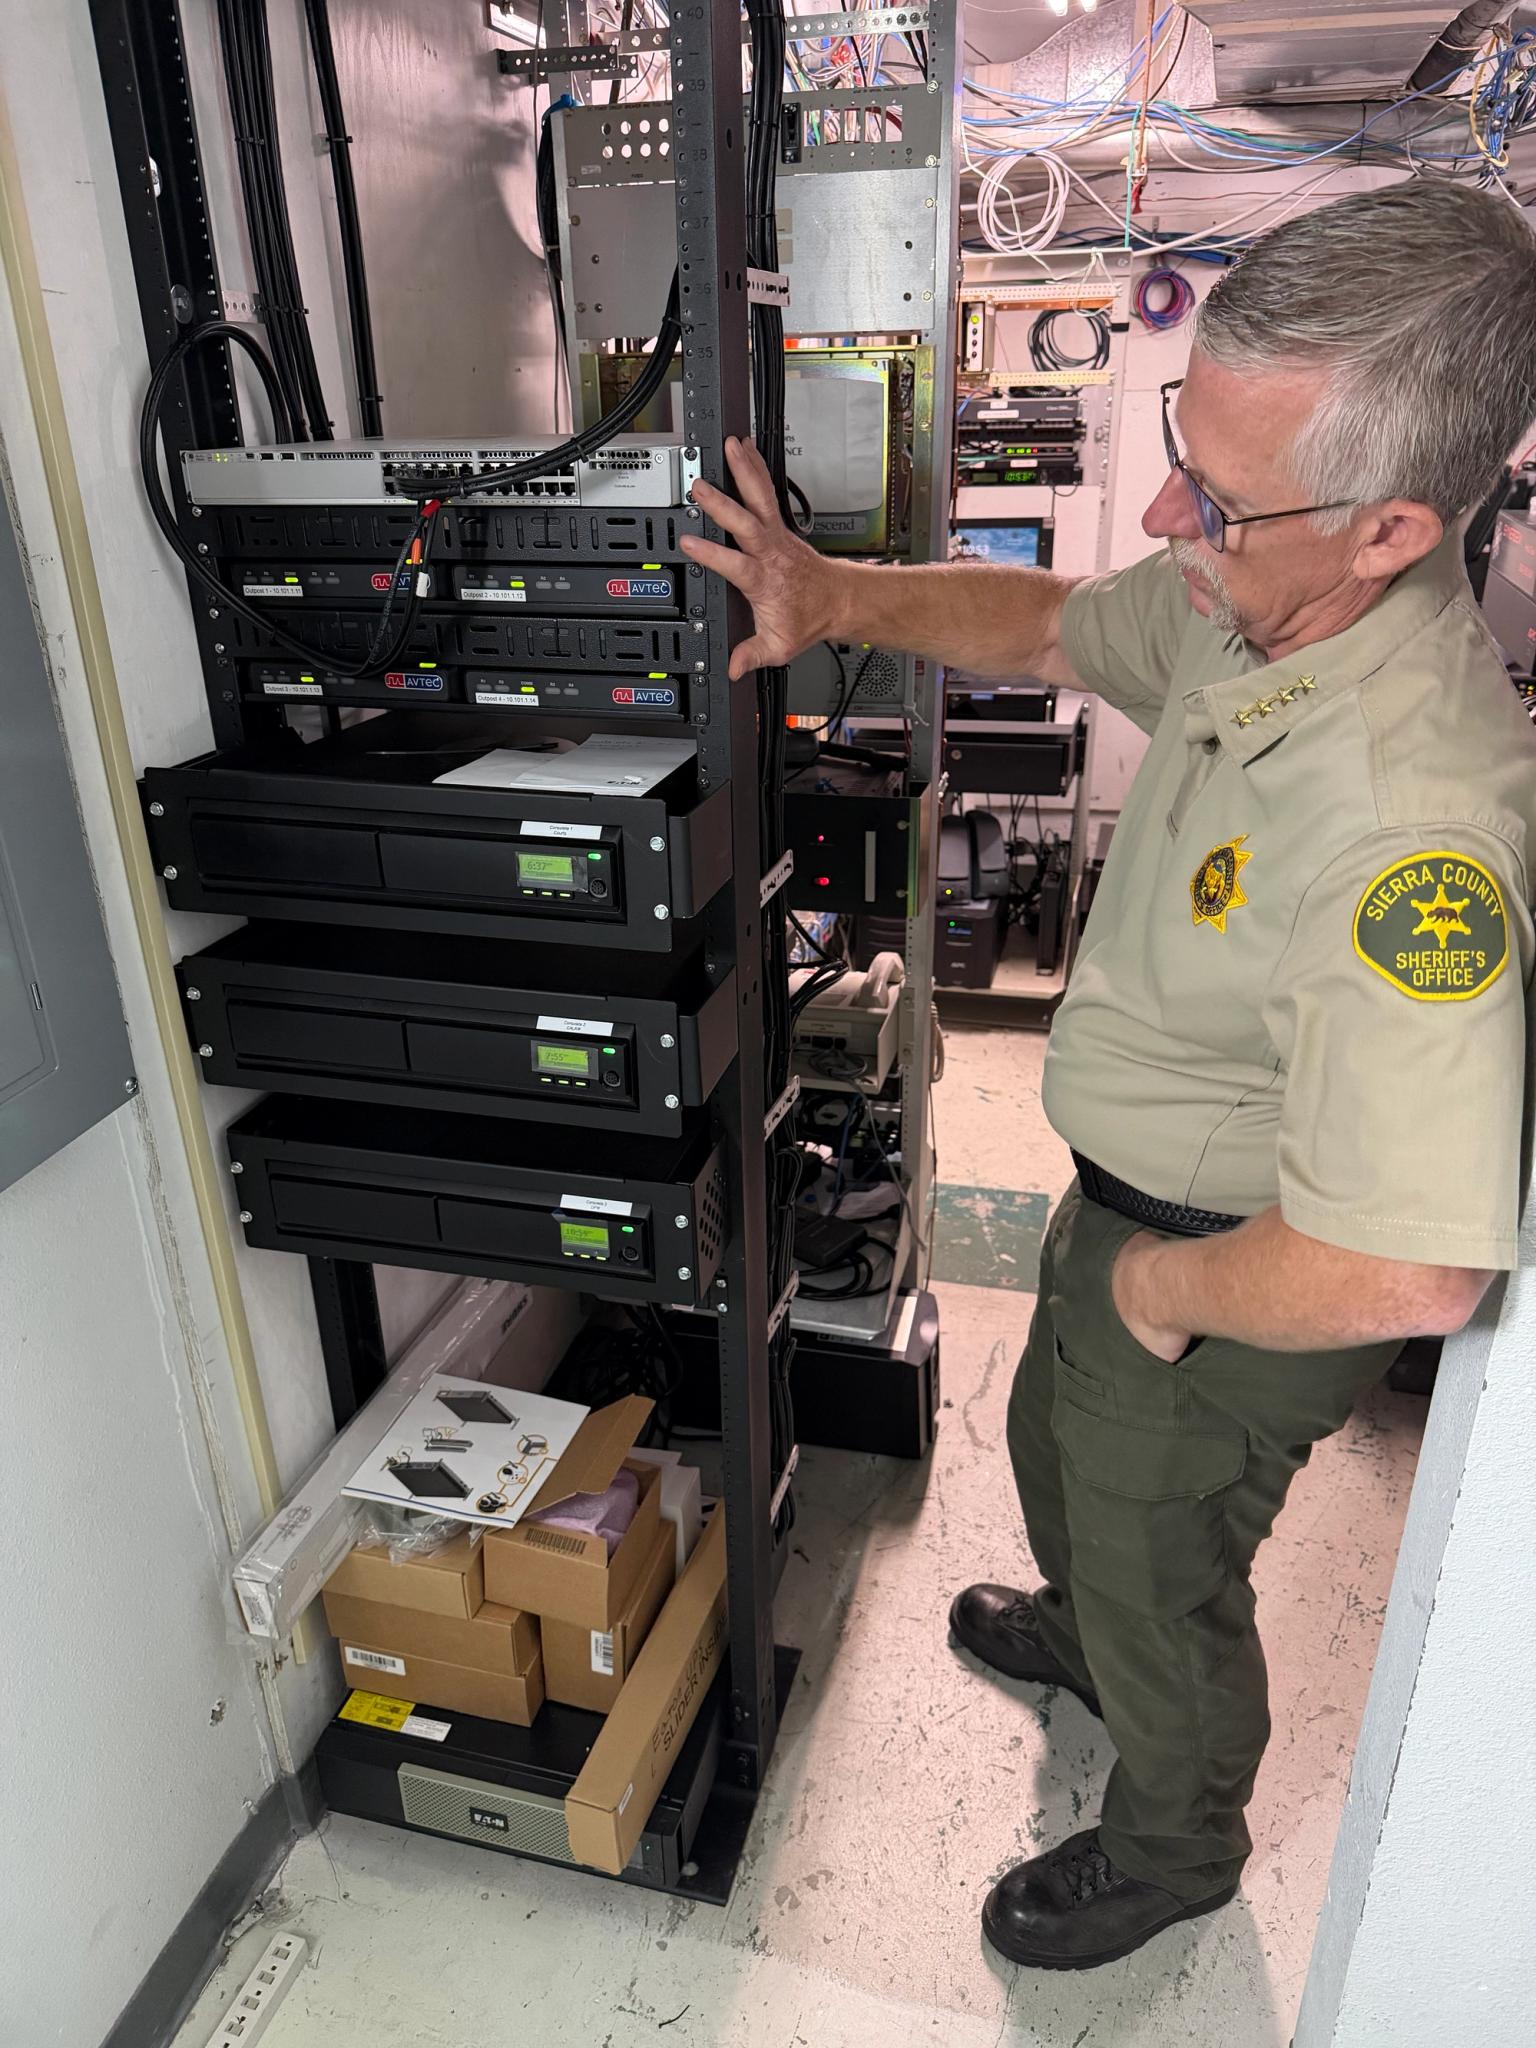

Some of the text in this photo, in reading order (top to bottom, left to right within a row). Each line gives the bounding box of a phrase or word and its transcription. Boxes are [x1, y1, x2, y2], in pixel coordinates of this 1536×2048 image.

[688, 79, 706, 92] 39
[700, 408, 715, 420] 34
[463, 591, 484, 600] Outpost
[493, 592, 523, 600] 10.101.1.12
[478, 694, 498, 703] Outpost
[1367, 863, 1501, 921] SIERRA COUNTY
[1396, 950, 1486, 969] SHERIFF'S
[1413, 968, 1474, 986] OFFICE
[663, 1677, 699, 1752] SLIDER
